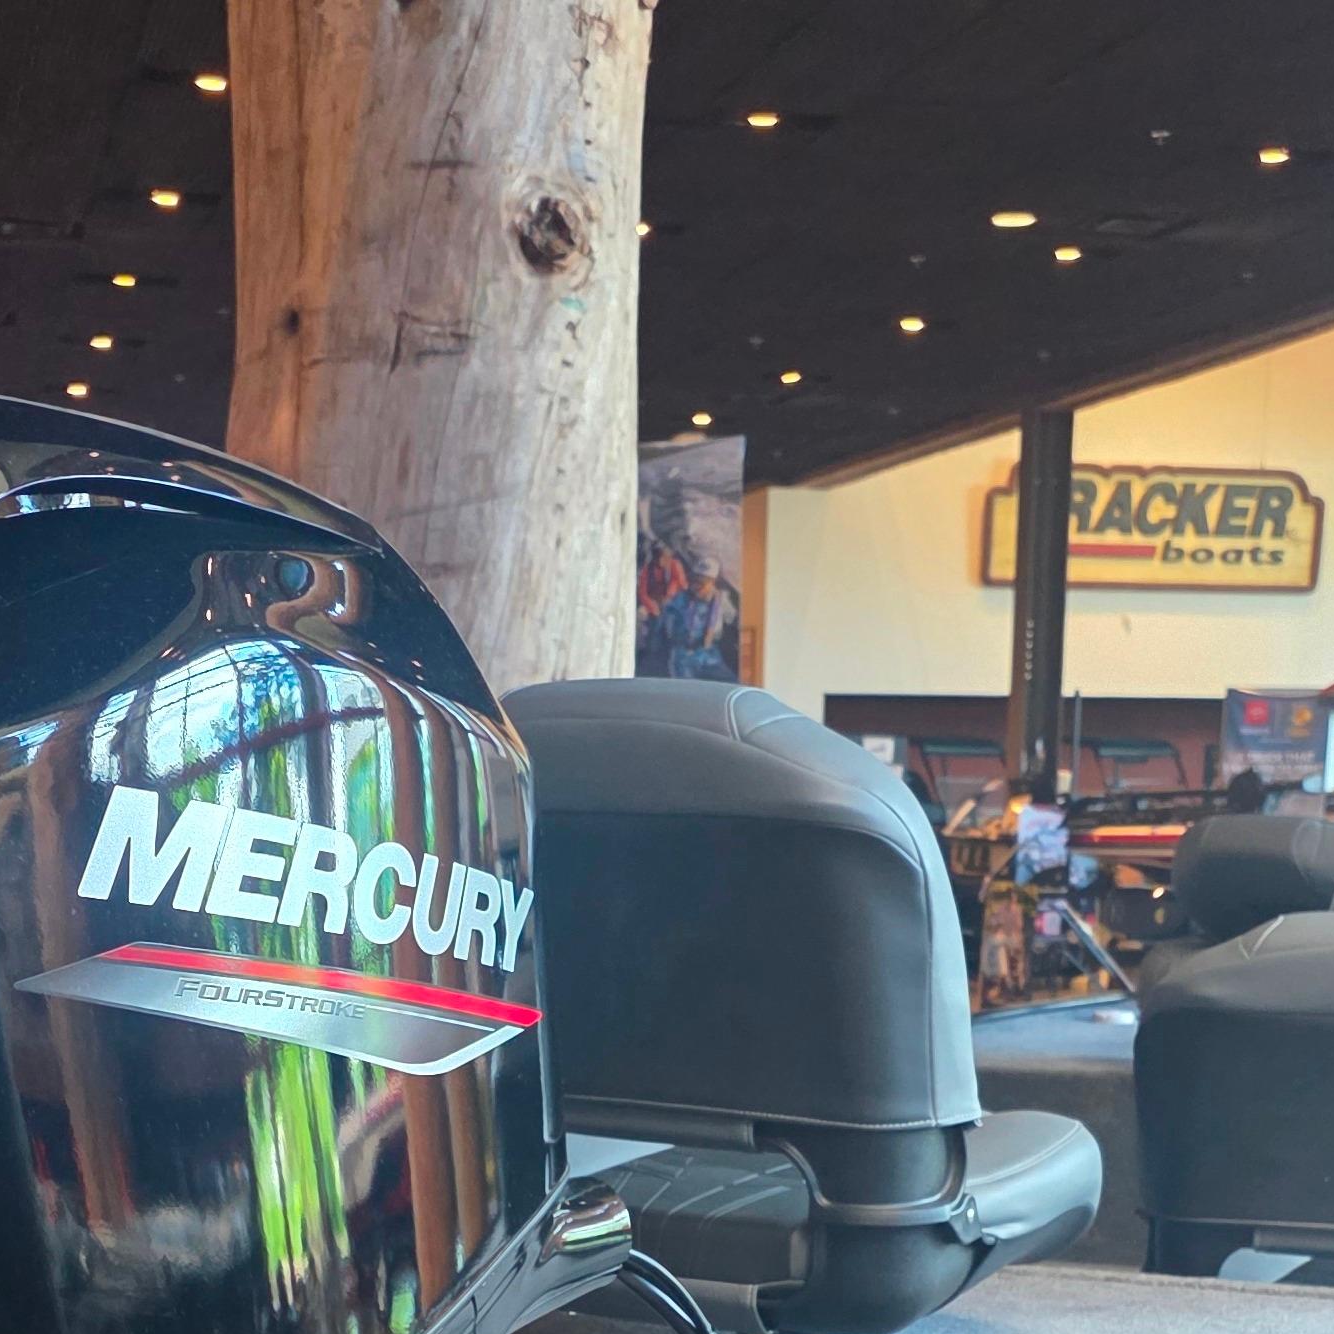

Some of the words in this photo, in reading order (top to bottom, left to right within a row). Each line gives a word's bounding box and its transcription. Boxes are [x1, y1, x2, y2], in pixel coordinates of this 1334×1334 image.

[1067, 478, 1294, 538] RACKER
[1161, 540, 1285, 565] boats
[77, 785, 535, 973] MERCURY
